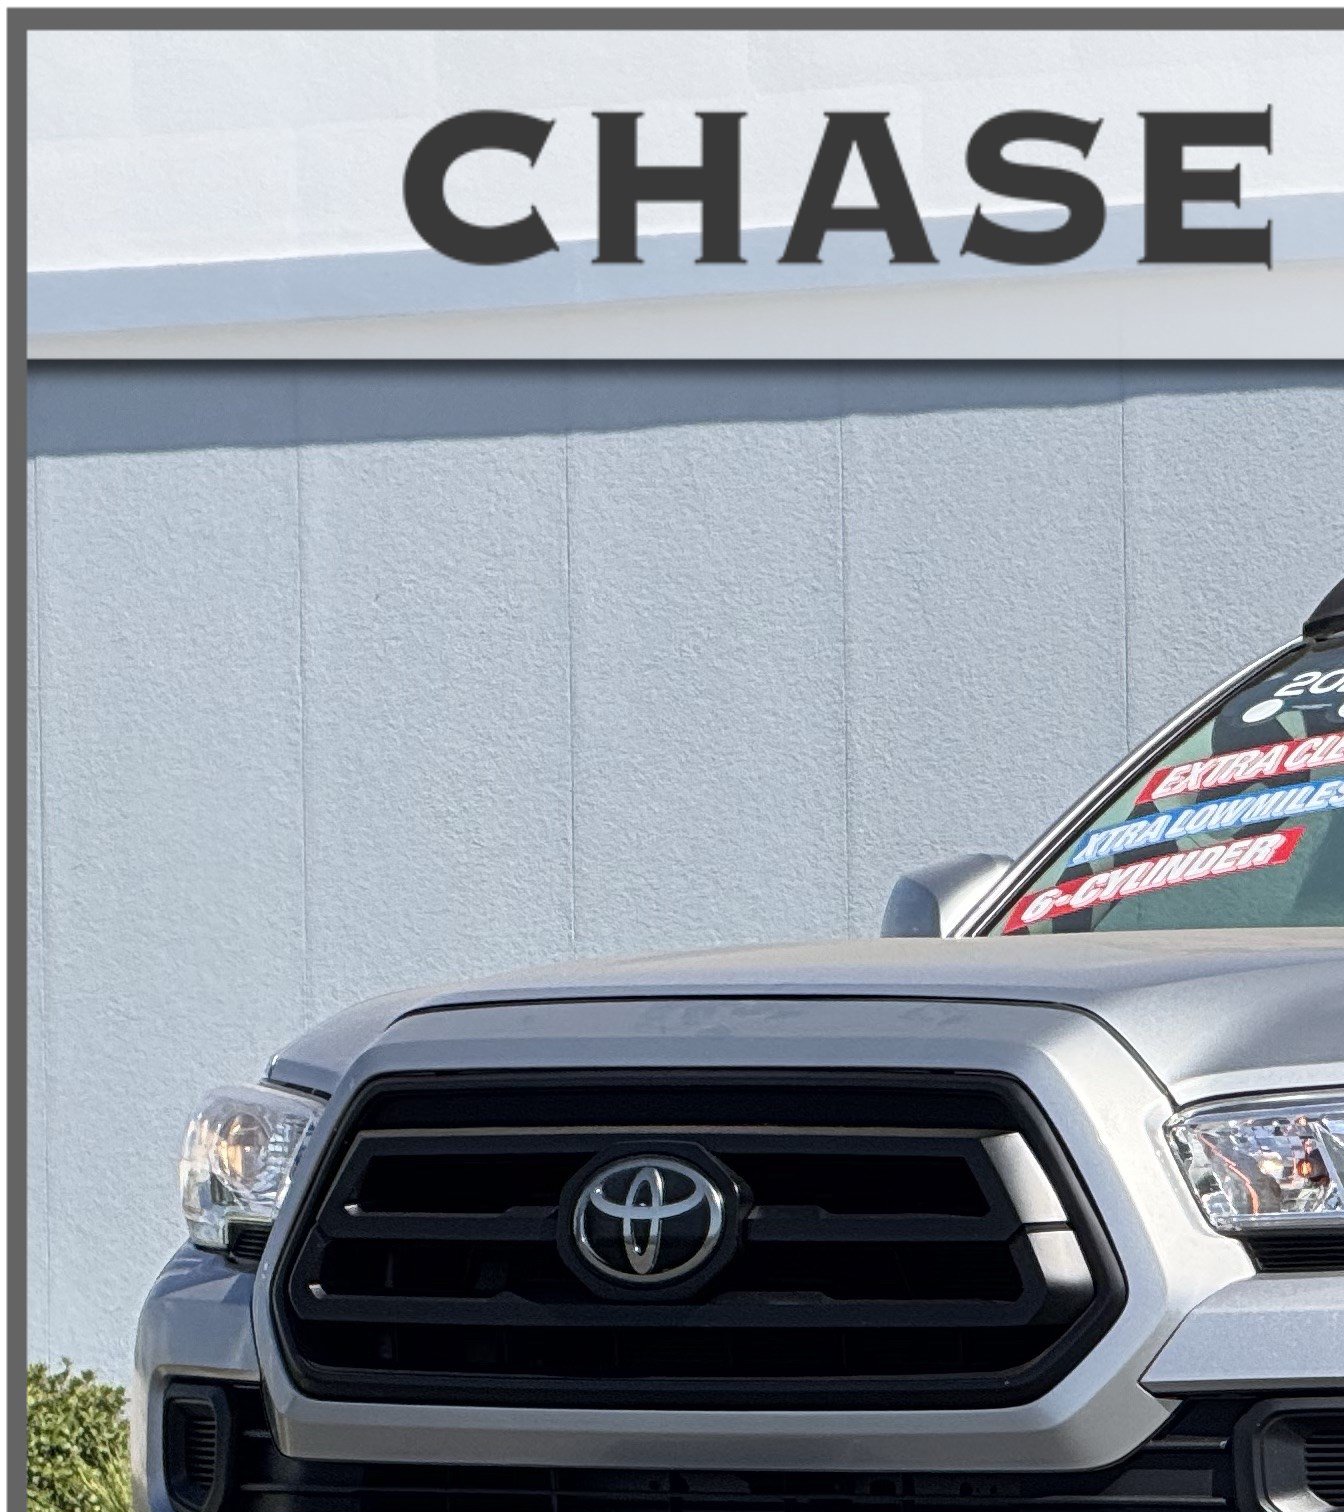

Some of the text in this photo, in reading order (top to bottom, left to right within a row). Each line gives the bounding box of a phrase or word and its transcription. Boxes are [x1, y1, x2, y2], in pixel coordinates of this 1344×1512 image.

[1150, 743, 1284, 800] EXTRA
[1073, 817, 1170, 864] XTRA
[1020, 830, 1288, 925] 6-CYLINDER
